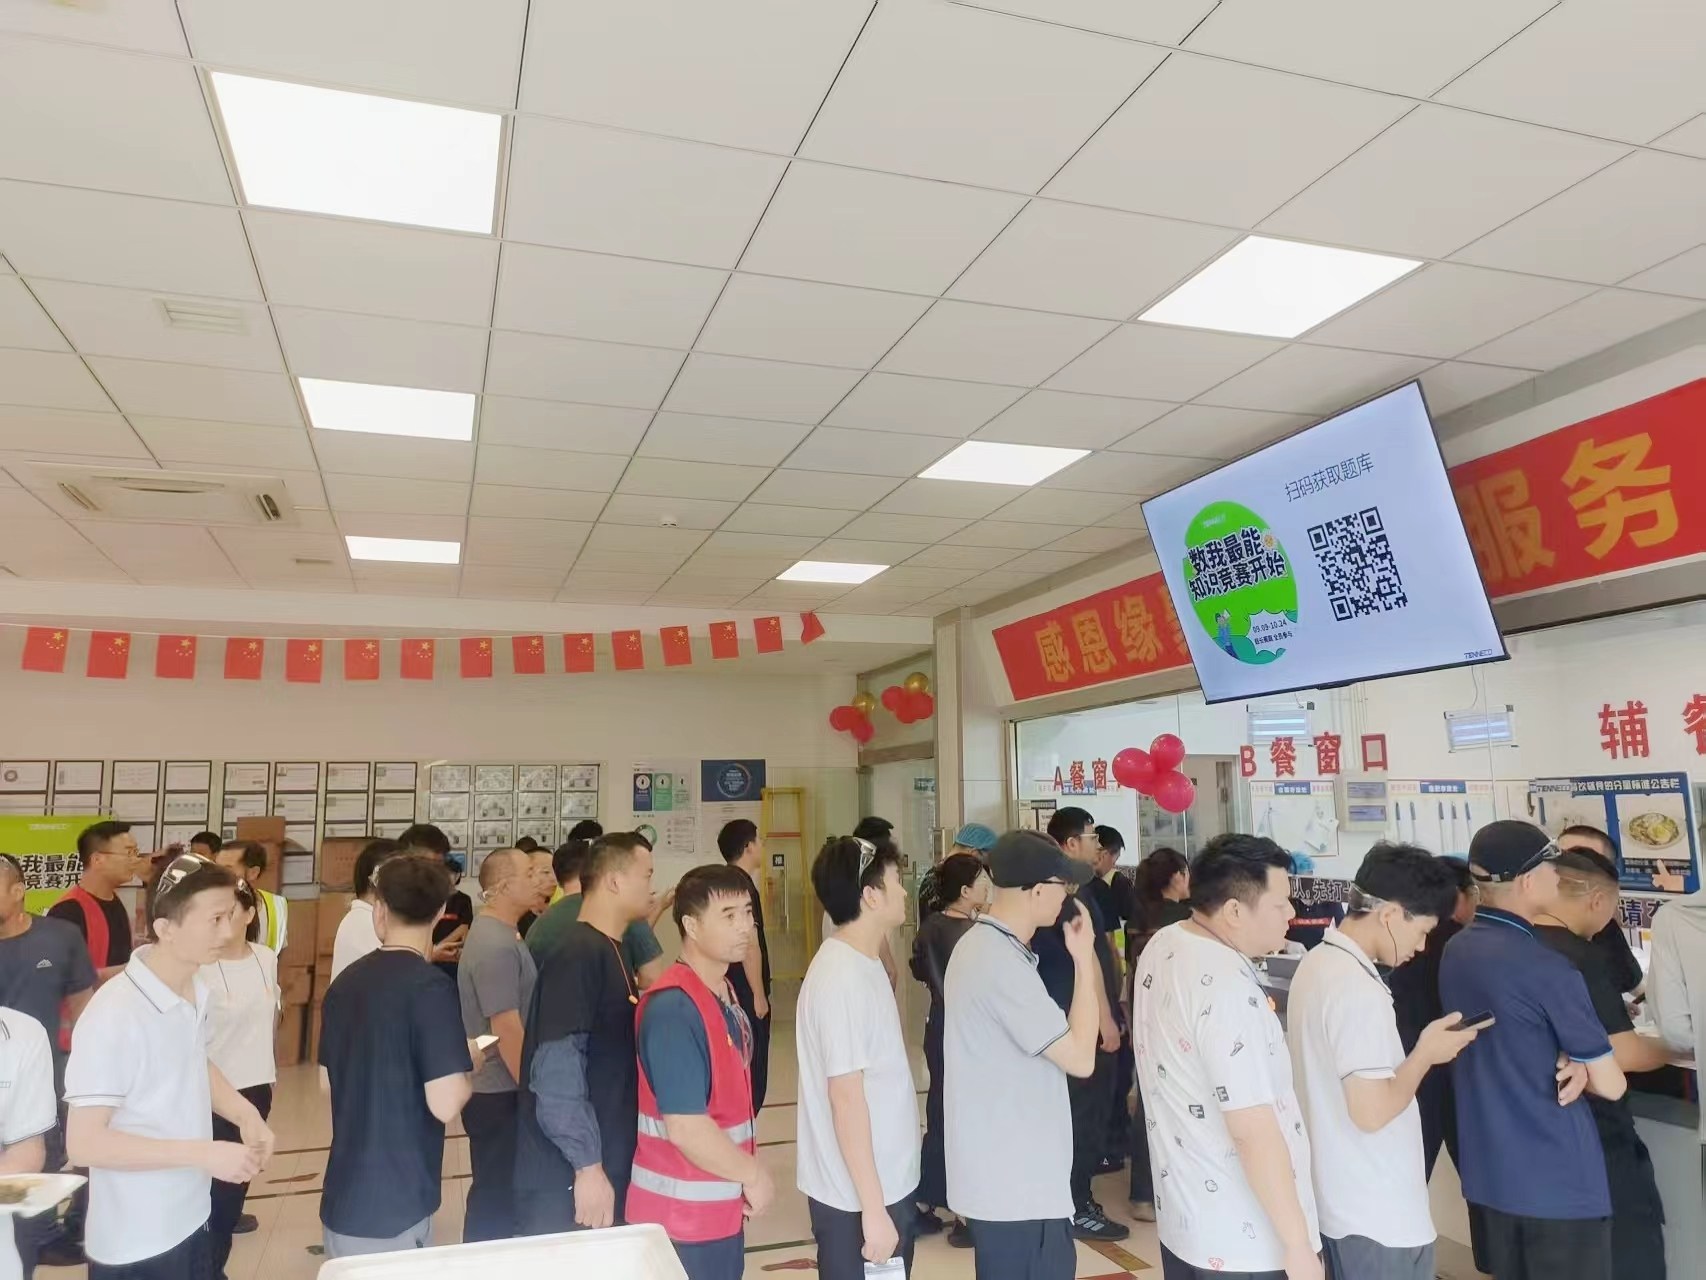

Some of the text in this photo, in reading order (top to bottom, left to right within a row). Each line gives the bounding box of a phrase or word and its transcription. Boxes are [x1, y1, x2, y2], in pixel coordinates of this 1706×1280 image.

[1285, 453, 1374, 502] 扫码获取题库
[1455, 432, 1678, 582] 服务
[1188, 526, 1265, 574] 数我最能
[1189, 551, 1286, 601] 知识竞赛开始
[1053, 757, 1120, 792] A餐窗
[1240, 731, 1388, 777] B餐窗口
[18, 854, 84, 872] 我最能
